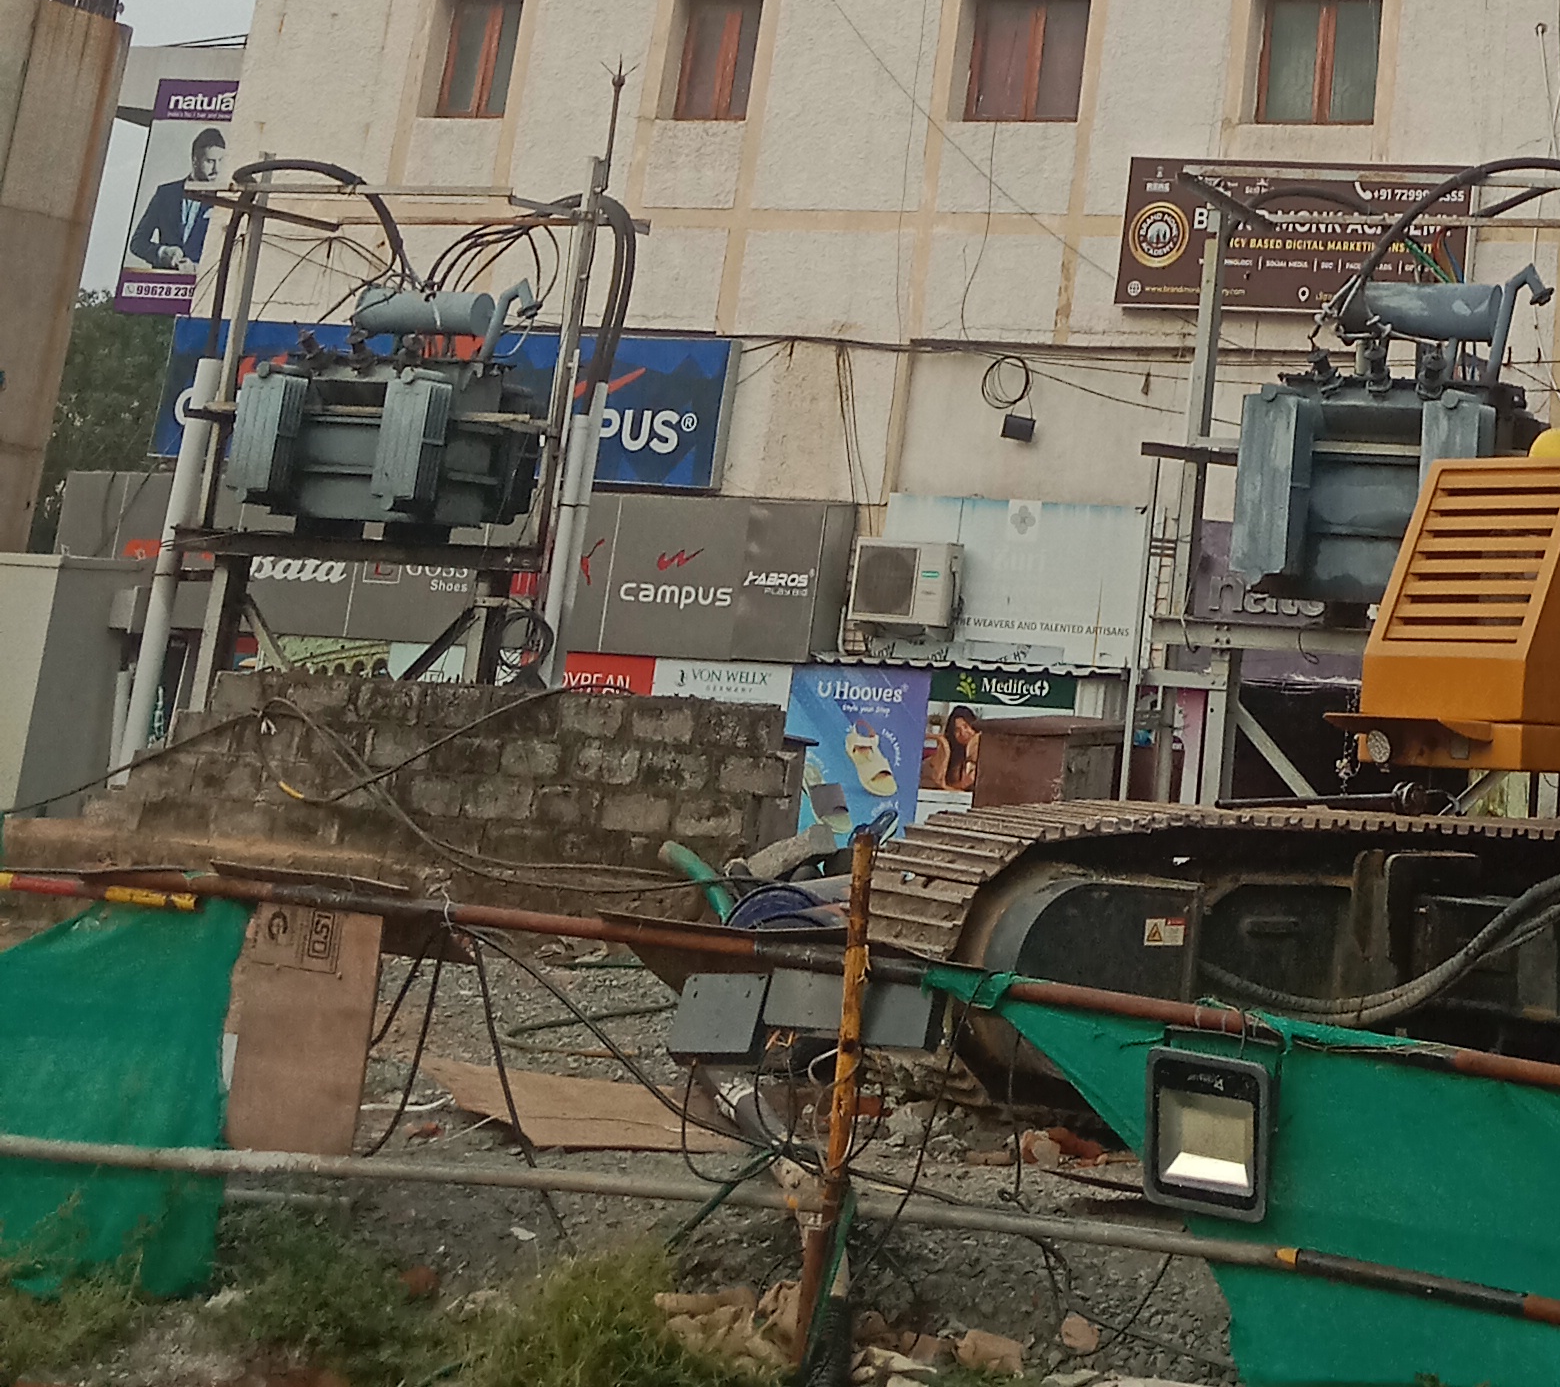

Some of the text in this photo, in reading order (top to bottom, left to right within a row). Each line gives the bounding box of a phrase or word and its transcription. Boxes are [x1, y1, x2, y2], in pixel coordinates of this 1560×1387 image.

[1249, 238, 1283, 249] BASED
[1285, 239, 1325, 250] DIGITAL
[1327, 240, 1375, 252] MARKETI
[136, 282, 172, 296] 99628
[430, 579, 468, 593] Shoes
[619, 582, 733, 610] campus
[974, 618, 1015, 630] WEAVERS
[1018, 620, 1037, 631] AND
[1039, 622, 1083, 634] TALENTED
[1085, 624, 1130, 637] ARTISANS
[692, 668, 724, 682] VON
[834, 680, 904, 703] Hooves
